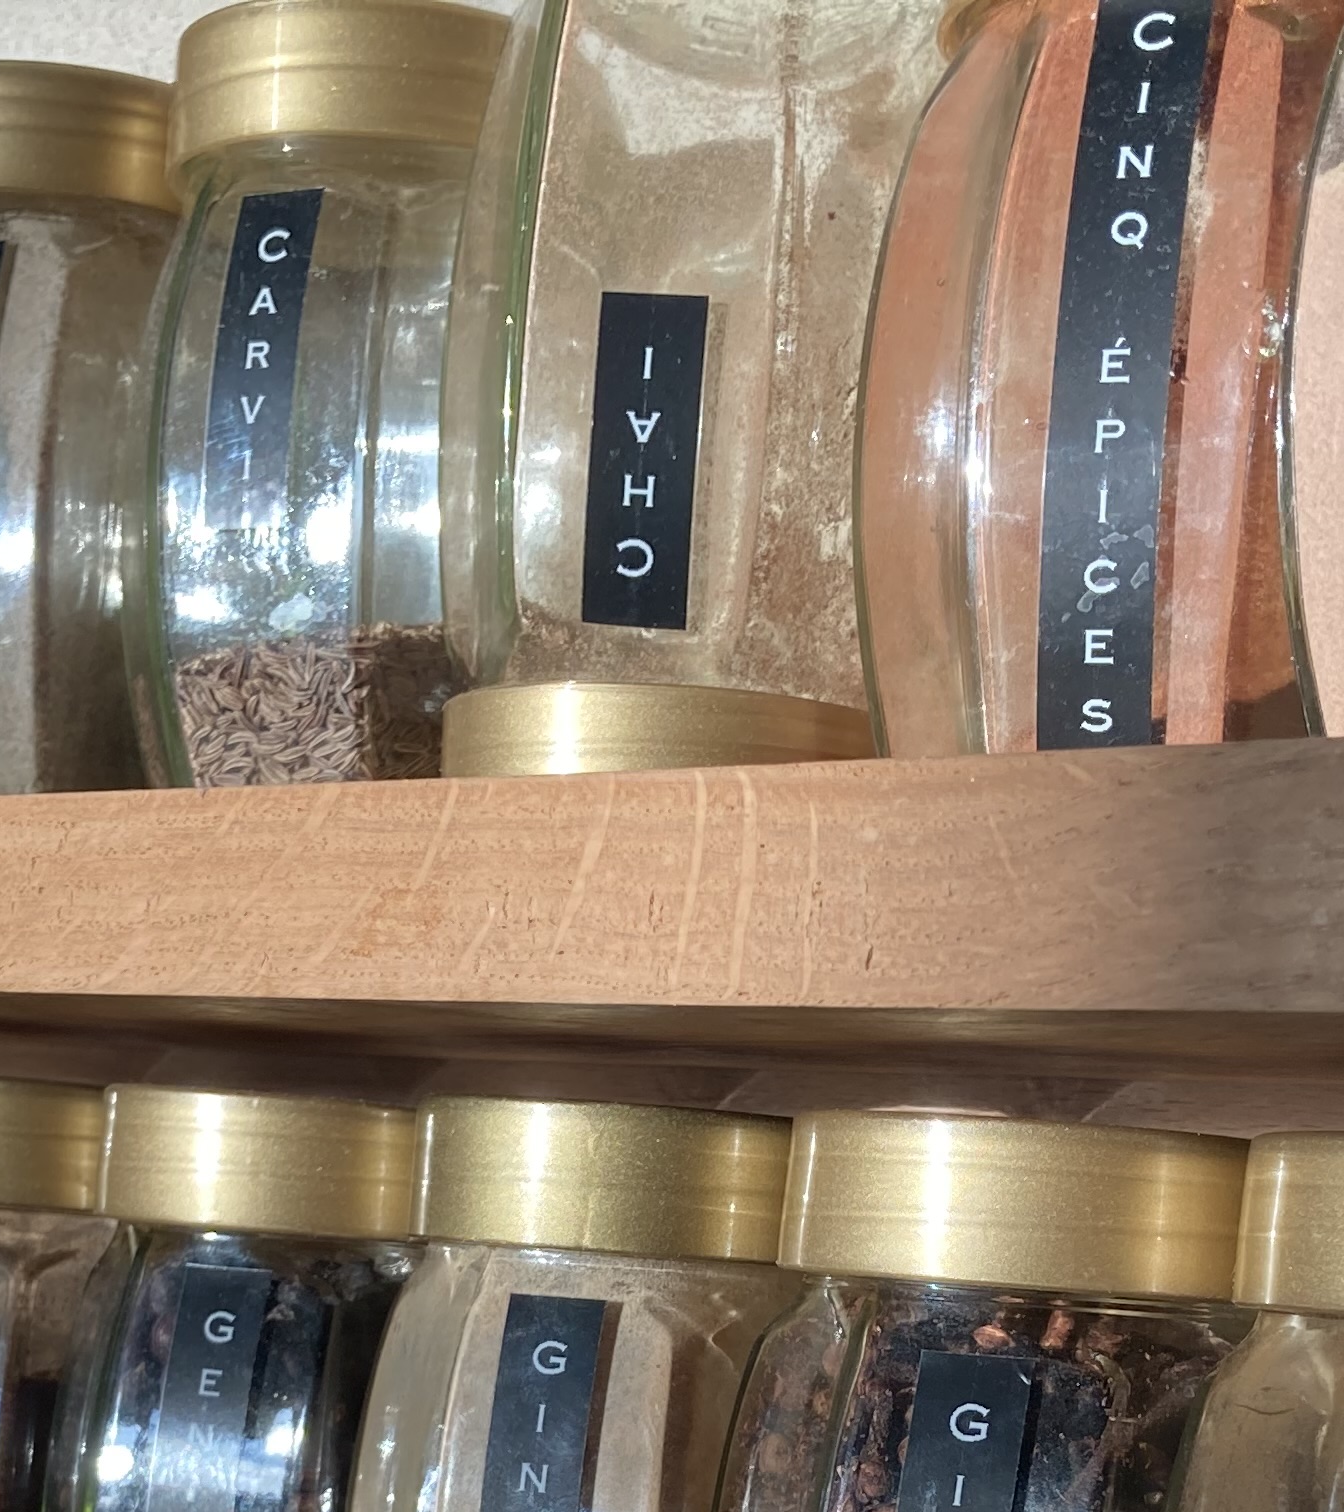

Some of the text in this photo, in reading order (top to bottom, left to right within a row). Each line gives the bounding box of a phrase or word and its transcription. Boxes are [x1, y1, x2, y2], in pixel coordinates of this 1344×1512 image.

[240, 227, 291, 480] CARVI
[614, 346, 661, 577] CHAI
[1080, 13, 1175, 733] CINQ ÉPICES
